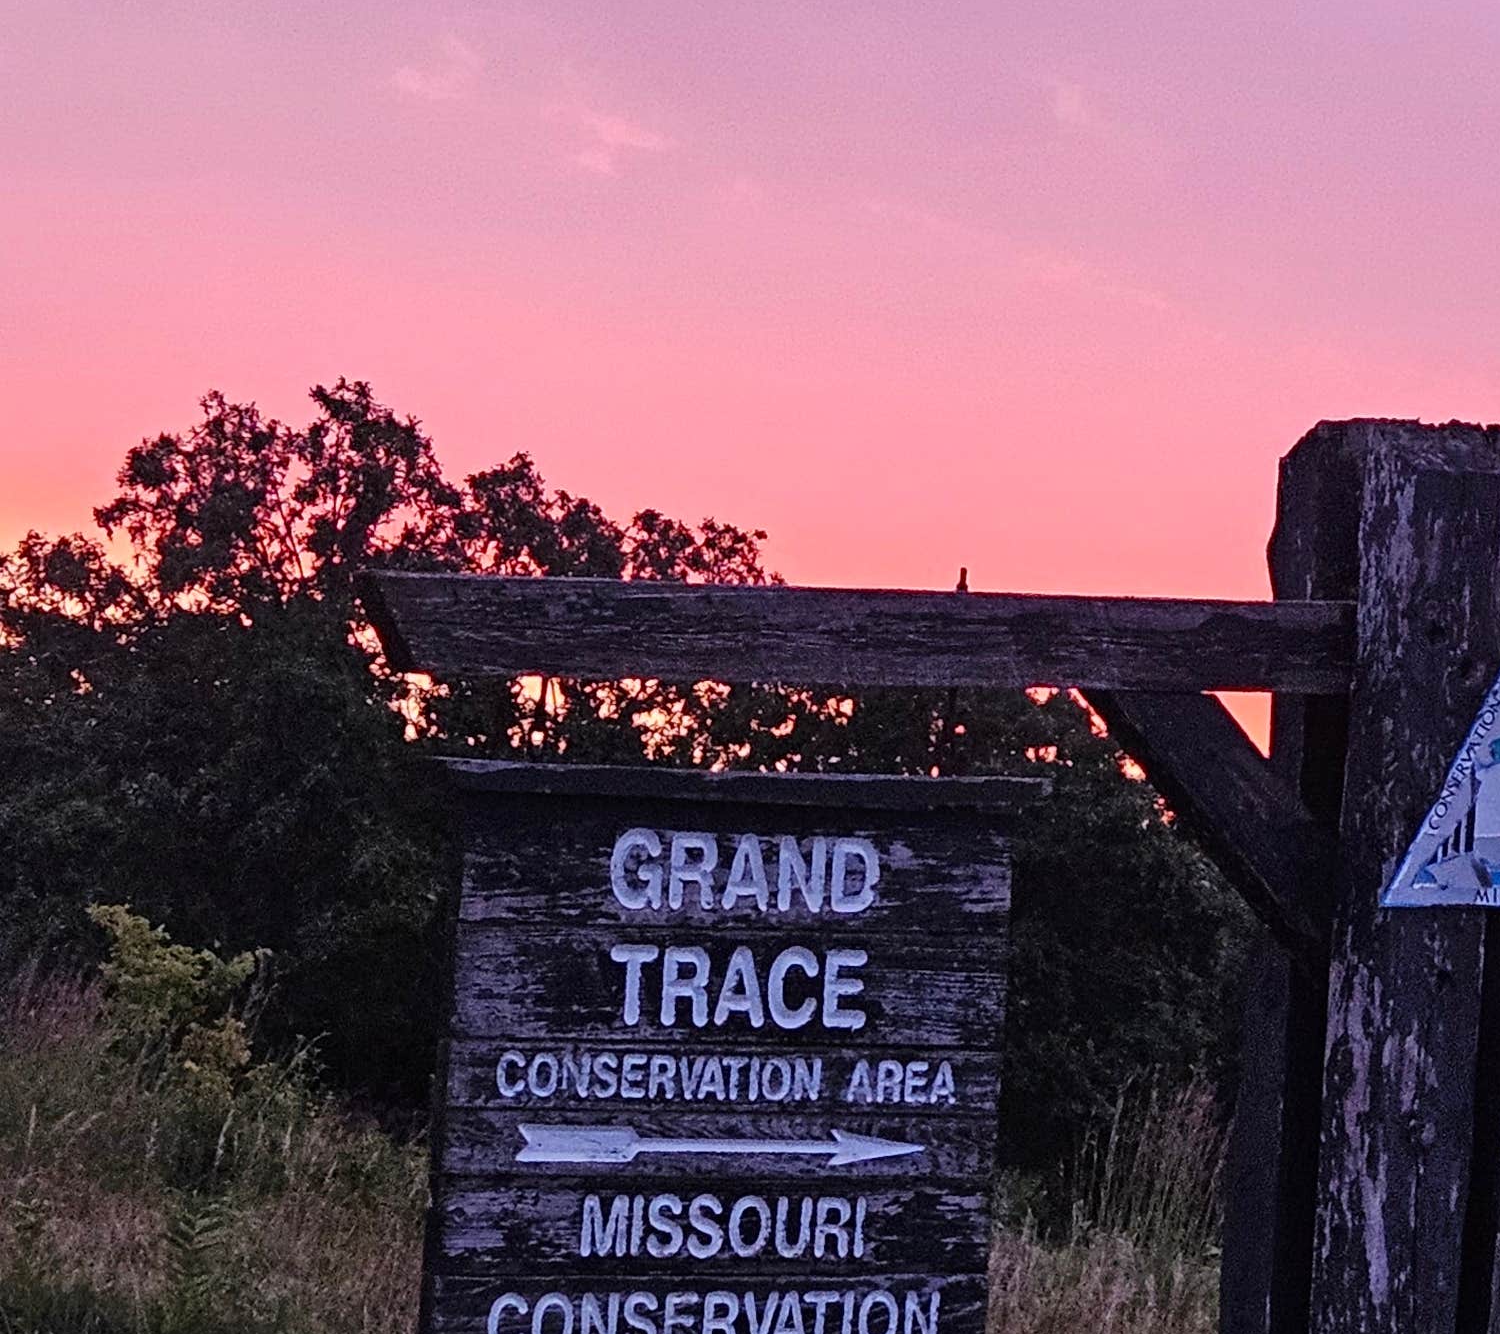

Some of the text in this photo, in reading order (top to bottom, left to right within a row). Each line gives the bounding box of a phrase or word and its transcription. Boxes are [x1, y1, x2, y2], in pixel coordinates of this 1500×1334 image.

[609, 828, 881, 913] GRAND
[609, 944, 869, 1030] TRACE
[496, 1050, 957, 1104] CONSERVATION AREA
[579, 1194, 867, 1259] MISSOURI
